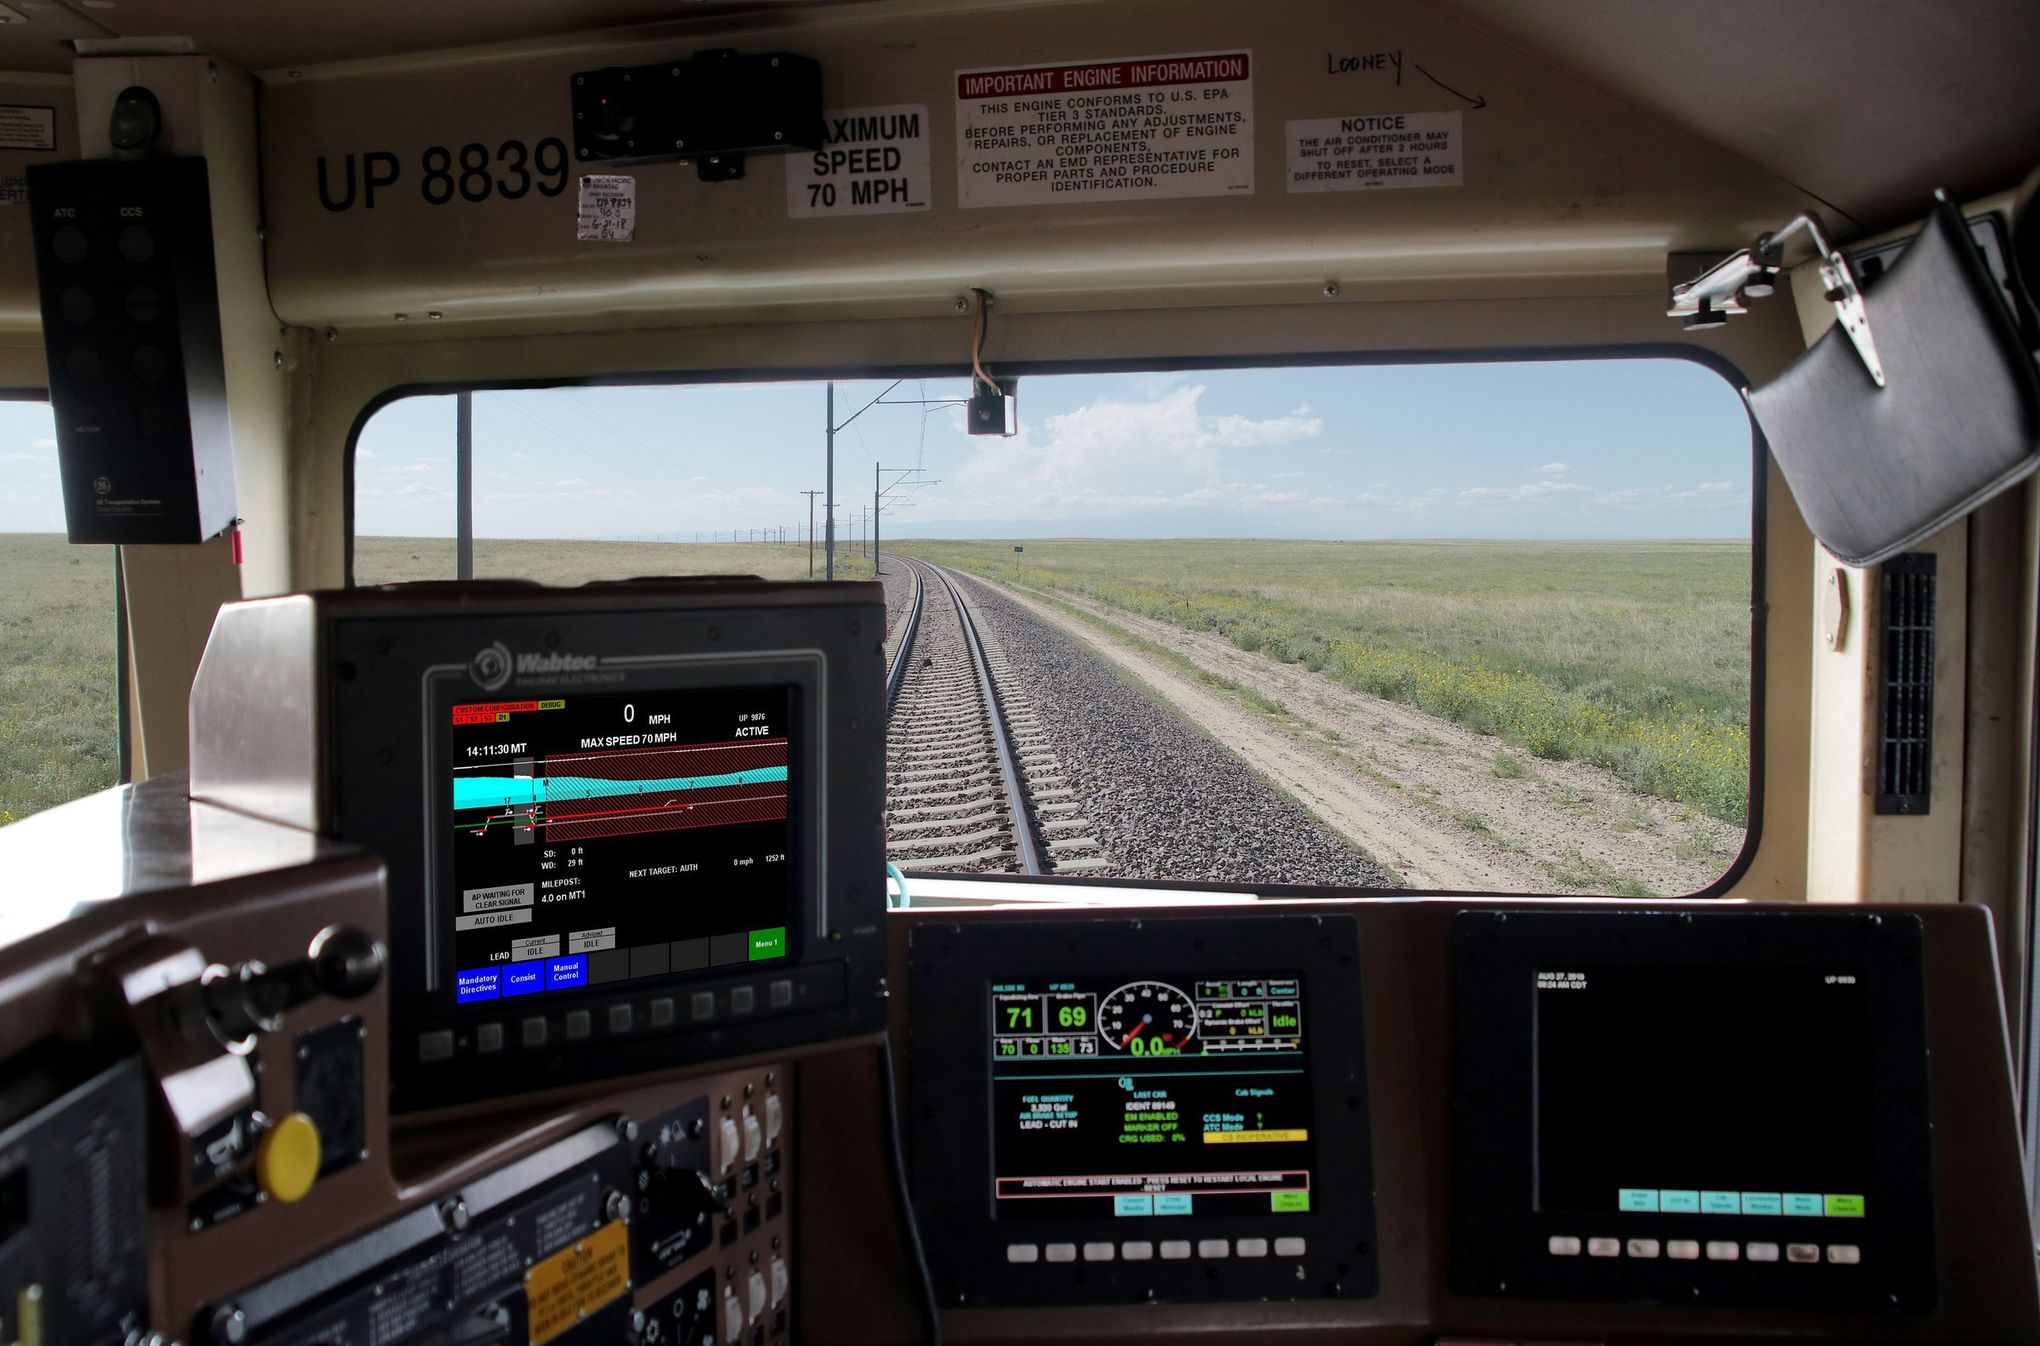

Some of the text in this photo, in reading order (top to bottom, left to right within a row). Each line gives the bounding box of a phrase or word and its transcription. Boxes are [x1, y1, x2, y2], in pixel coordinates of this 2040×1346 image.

[1328, 50, 1402, 86] LOONEY
[965, 59, 1242, 95] IMPORTANT ENGINE INFORMATION
[980, 89, 1229, 114] THIS ENGINE CONFORMS TO U.S. EPA
[1038, 105, 1167, 122] TIER 3 STANDARDS.
[822, 114, 919, 143] AXIMUM
[965, 112, 1246, 139] BEFORE PERFORMING ANY ADJUSTMENTS,
[1341, 116, 1405, 132] NOTICE
[1037, 136, 1054, 146] OR
[1061, 129, 1156, 144] REPLACEMENT
[1163, 128, 1180, 138] OF
[1187, 124, 1236, 137] ENGINE
[1299, 132, 1449, 147] THE AIR CONDITIONER MAY
[1056, 142, 1151, 157] COMPONENTS,
[1300, 142, 1448, 157] SHUT OFF AFTER 2 HOURS
[814, 147, 900, 176] SPEED
[973, 148, 1239, 173] CONTACT AN EMD REPRESENTATIVE FOR
[1317, 162, 1331, 170] TO
[1337, 160, 1372, 169] RESET,
[1378, 157, 1418, 167] SELECT
[317, 137, 568, 211] UP 8839
[996, 162, 1215, 183] PROPER PARTS AND PROCEDURE
[1294, 165, 1455, 181] DIFFERENT OPERATING MODE
[1051, 178, 1157, 192] IDENTIFICATION.
[807, 178, 907, 207] 70 MPH
[54, 208, 76, 218] ATC
[120, 207, 143, 217] CCS
[516, 651, 596, 674] Wabtec
[455, 702, 534, 714] CUSTOM CONFIGURATION
[624, 704, 671, 725] 0 MPH
[739, 714, 748, 722] UP
[735, 725, 769, 737] ACTIVE
[581, 732, 677, 749] MAX SPEED 70 MPH
[466, 742, 527, 757] 14:11:30 MT
[544, 850, 556, 858] SD:
[765, 854, 779, 862] 1252
[541, 862, 556, 870] WD:
[568, 860, 576, 868] 29
[733, 857, 754, 866] 0 mph
[629, 863, 698, 878] NEXT TARGET: AUTH
[541, 878, 581, 889] MILEPOST:
[472, 893, 482, 901] AP
[482, 890, 510, 900] WAITING
[541, 894, 554, 903] 4.0
[568, 890, 586, 900] MT1
[475, 898, 522, 909] CLEAR SIGNAL
[474, 914, 513, 925] AUTO IDLE
[584, 939, 600, 948] IDLE
[755, 940, 773, 948] Menu
[490, 952, 510, 961] LEAD
[527, 947, 543, 955] IDLE
[553, 962, 579, 972] Manual
[459, 974, 497, 986] Mandatory
[510, 973, 536, 983] Consist
[554, 971, 579, 981] Control
[460, 984, 496, 994] Directives
[1270, 986, 1296, 995] Center
[1006, 1007, 1032, 1028] 71
[1058, 1006, 1087, 1027] 69
[1273, 1015, 1297, 1028] Idle
[1001, 1044, 1015, 1055] 70
[1030, 1044, 1038, 1055] 0
[1079, 1042, 1094, 1054] 73
[1130, 1036, 1163, 1056] 0.0
[1139, 1112, 1178, 1121] ENABLED
[1020, 1120, 1043, 1129] LEAD
[1161, 1123, 1178, 1131] OFF
